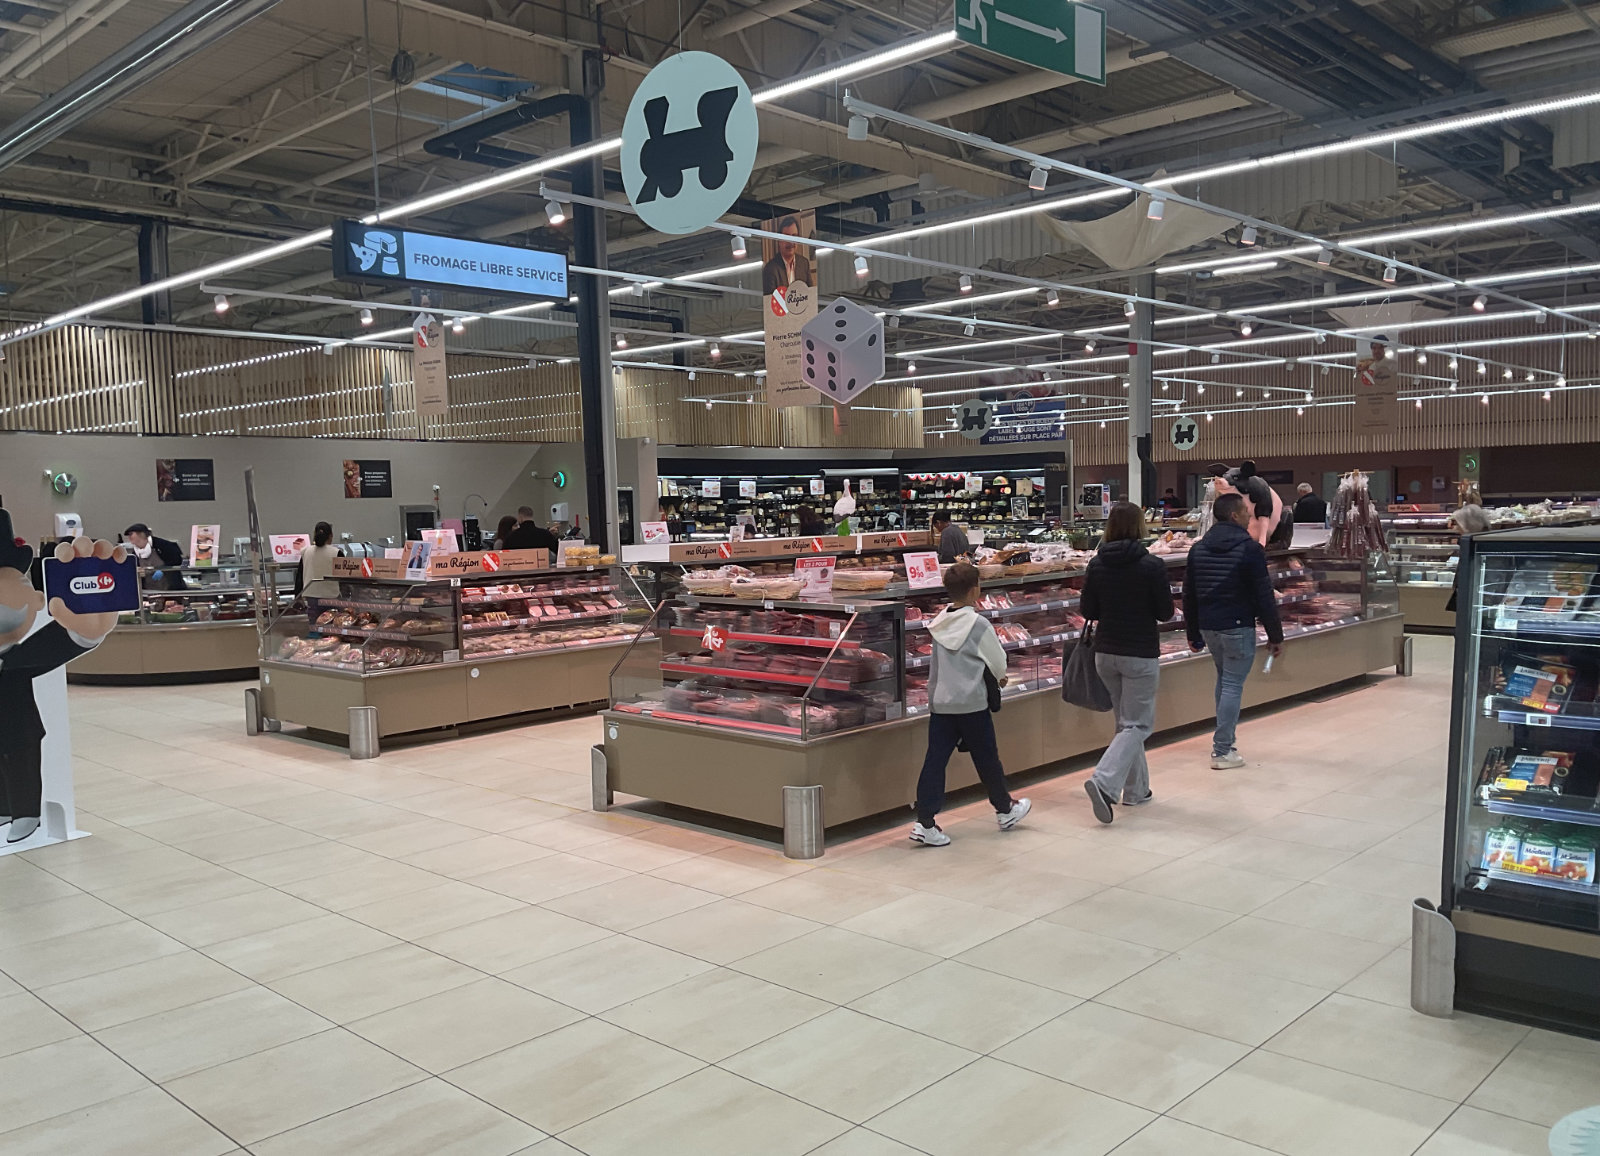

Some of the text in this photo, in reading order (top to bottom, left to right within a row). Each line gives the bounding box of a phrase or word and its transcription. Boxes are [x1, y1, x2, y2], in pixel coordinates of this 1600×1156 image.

[414, 253, 564, 282] FROMAGE LIBRE SERVICE
[792, 540, 810, 553] Région
[882, 536, 896, 547] Région
[686, 546, 717, 559] ma Région
[342, 559, 360, 575] Région
[435, 556, 479, 573] ma Région
[74, 581, 97, 589] Club
